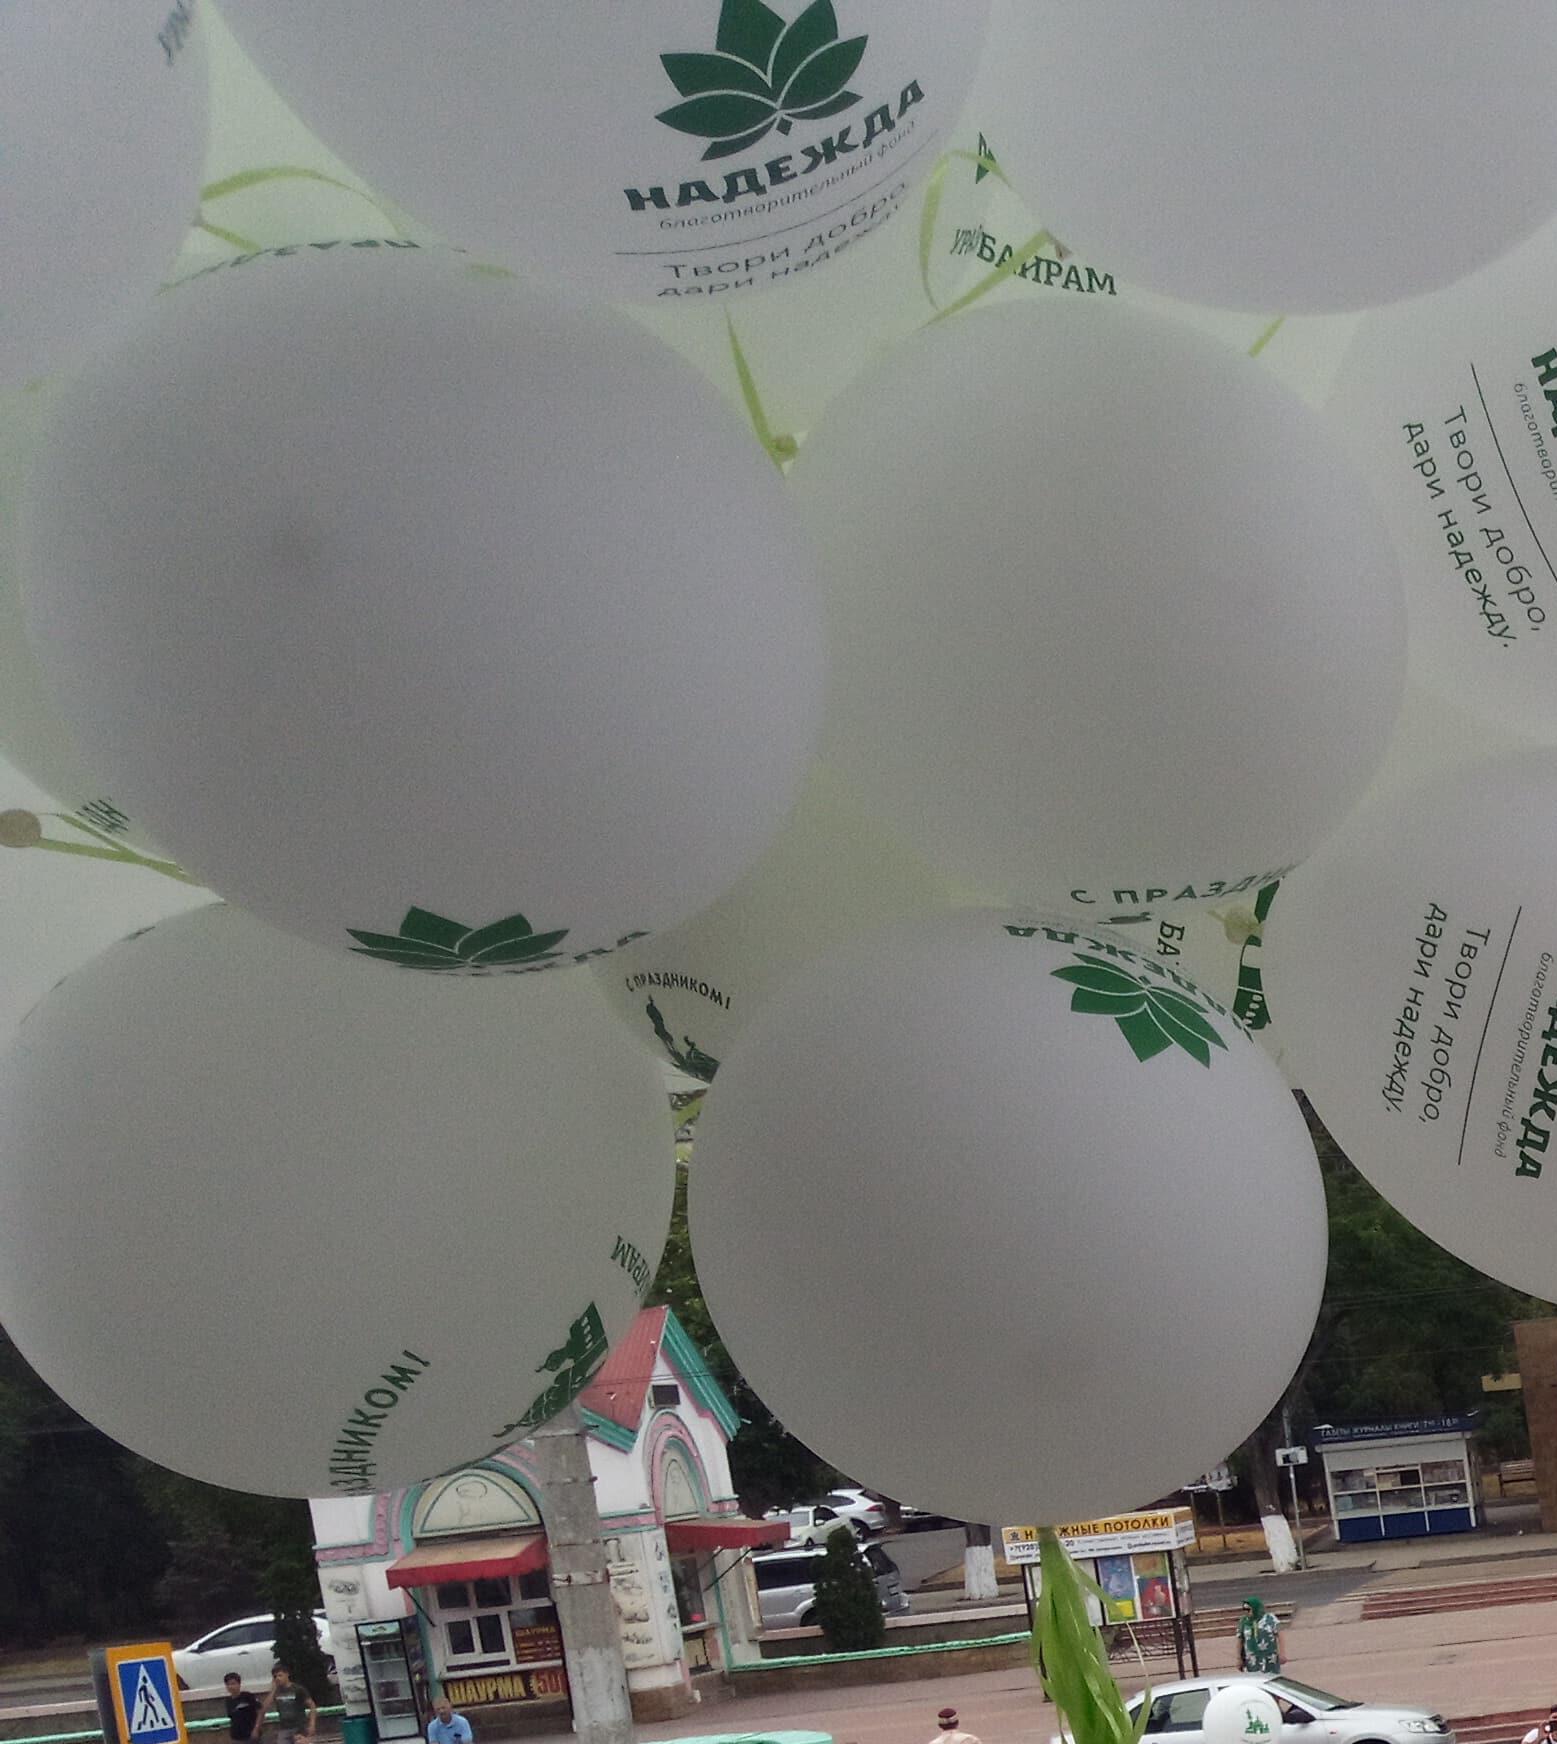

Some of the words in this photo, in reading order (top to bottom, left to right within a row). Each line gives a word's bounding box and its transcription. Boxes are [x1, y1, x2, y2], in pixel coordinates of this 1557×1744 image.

[623, 79, 925, 211] НАДЕЖДА
[663, 247, 790, 279] Твори
[1402, 421, 1446, 501] дари
[1437, 509, 1518, 648] надежду.
[1444, 404, 1492, 516] Твори
[1479, 526, 1546, 632] добро,
[1415, 902, 1448, 979] дари
[1445, 927, 1491, 1020] Твори
[633, 971, 731, 1010] ПРАЗДНИКОМ!
[1504, 952, 1554, 1120] благотворительный
[1382, 987, 1425, 1113] надежду.
[1419, 1025, 1453, 1123] добро,
[1494, 1119, 1512, 1158] фонд
[1024, 1524, 1099, 1540] НЖНЫЕ
[1104, 1516, 1169, 1533] ПОТОЛКИ
[449, 1674, 527, 1705] ШАУРМА
